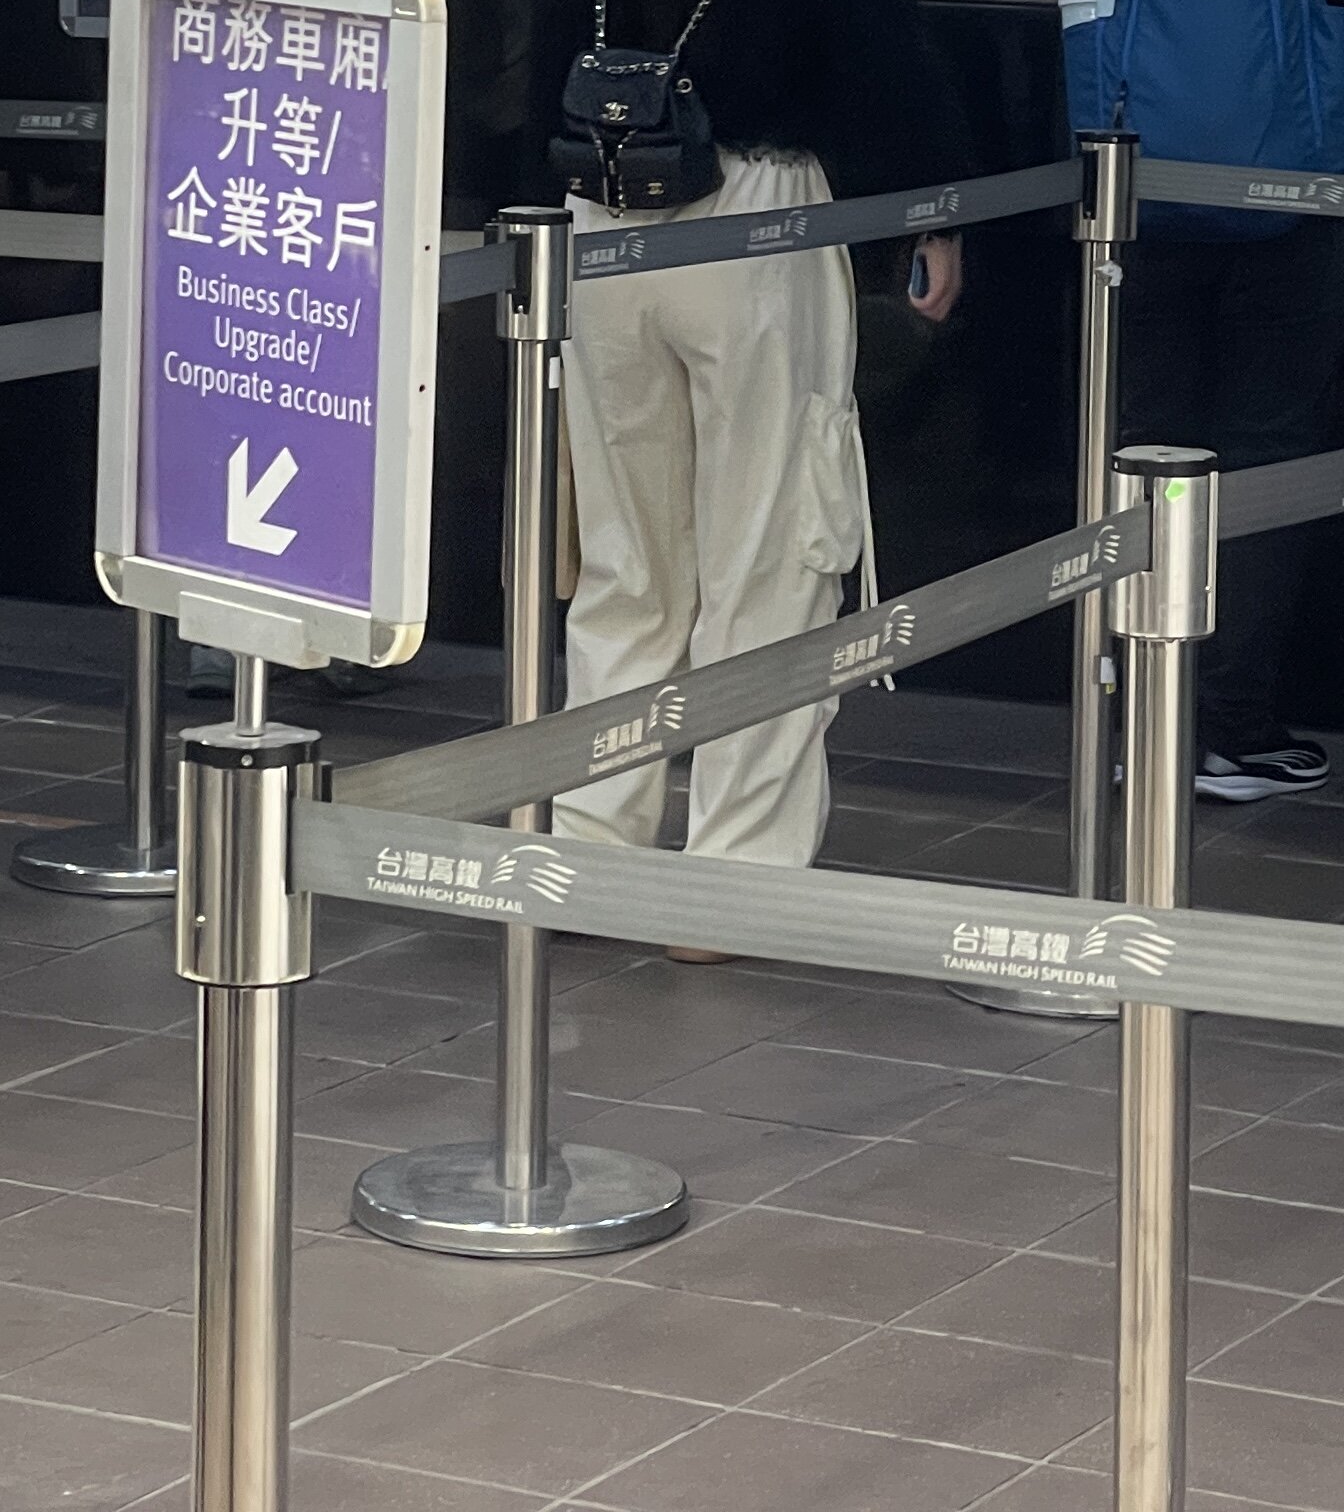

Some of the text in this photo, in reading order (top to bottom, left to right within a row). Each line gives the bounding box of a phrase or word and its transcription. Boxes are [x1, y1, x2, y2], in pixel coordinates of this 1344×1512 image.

[218, 88, 342, 175] 升等/
[167, 166, 377, 272] 企業客戶
[178, 264, 360, 337] Business Class/
[215, 317, 322, 373] Upgrade/
[164, 351, 372, 426] Corporate account
[366, 876, 526, 915] TAIWAN HIGH SPEED RAIL
[376, 846, 485, 890] 台灣高鐵
[952, 921, 1072, 966] 台灣高鐵
[942, 954, 1120, 991] TAIWAN HIGH SPEED RAIL
